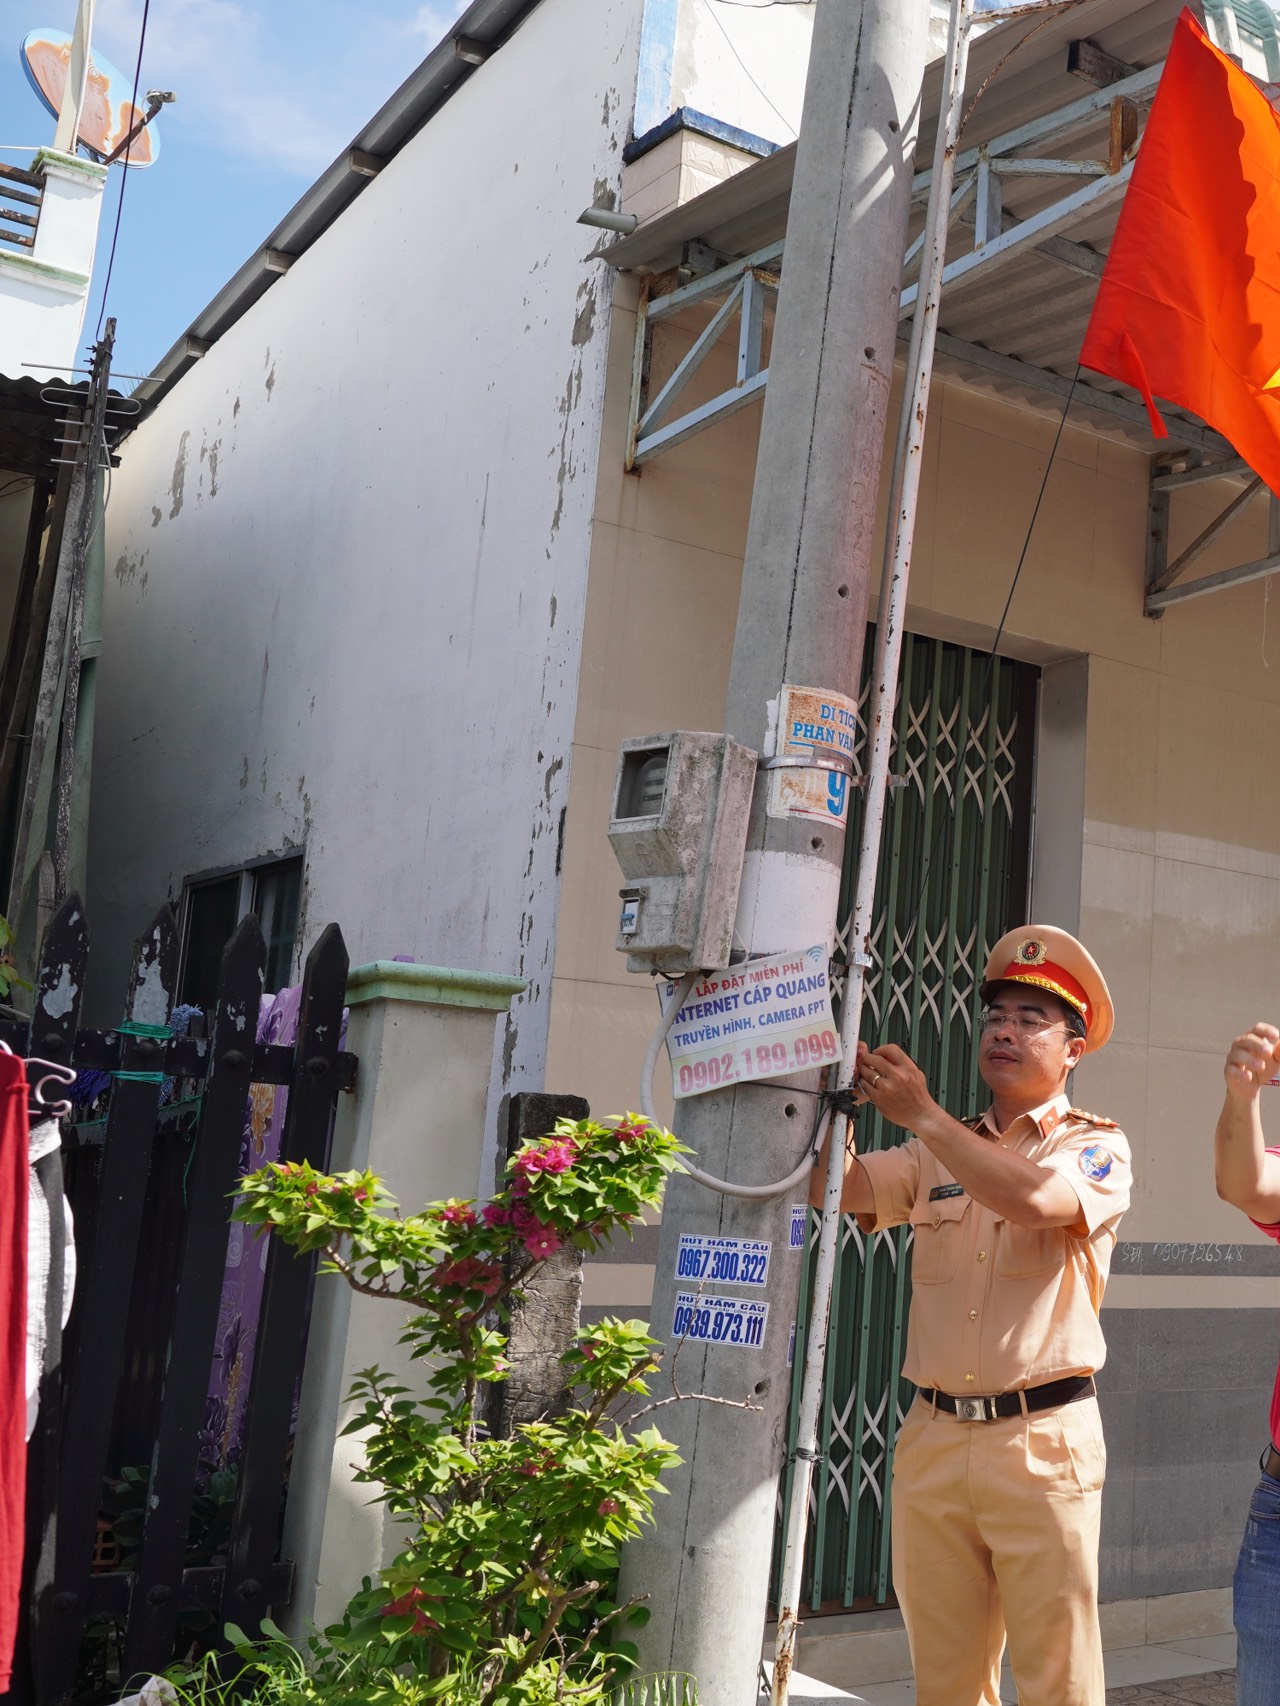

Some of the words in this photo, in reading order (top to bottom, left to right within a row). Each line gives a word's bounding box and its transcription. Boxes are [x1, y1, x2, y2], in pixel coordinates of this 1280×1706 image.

[820, 705, 836, 720] DI
[792, 722, 835, 743] PHAN
[696, 978, 718, 998] LẮP
[721, 974, 745, 991] ĐẶT
[749, 964, 780, 983] MIỄN
[783, 958, 804, 976] PHÍ
[672, 994, 740, 1024] NTERNET
[744, 984, 772, 1006] CÁP
[775, 973, 826, 999] QUANG
[675, 1025, 721, 1047] TRUYỀN
[759, 1005, 805, 1026] CAMERA
[808, 999, 825, 1015] FPT
[679, 1030, 838, 1093] 0902.189.099
[678, 1248, 766, 1283] 0967.300.322
[674, 1306, 763, 1344] 0939.973.111
